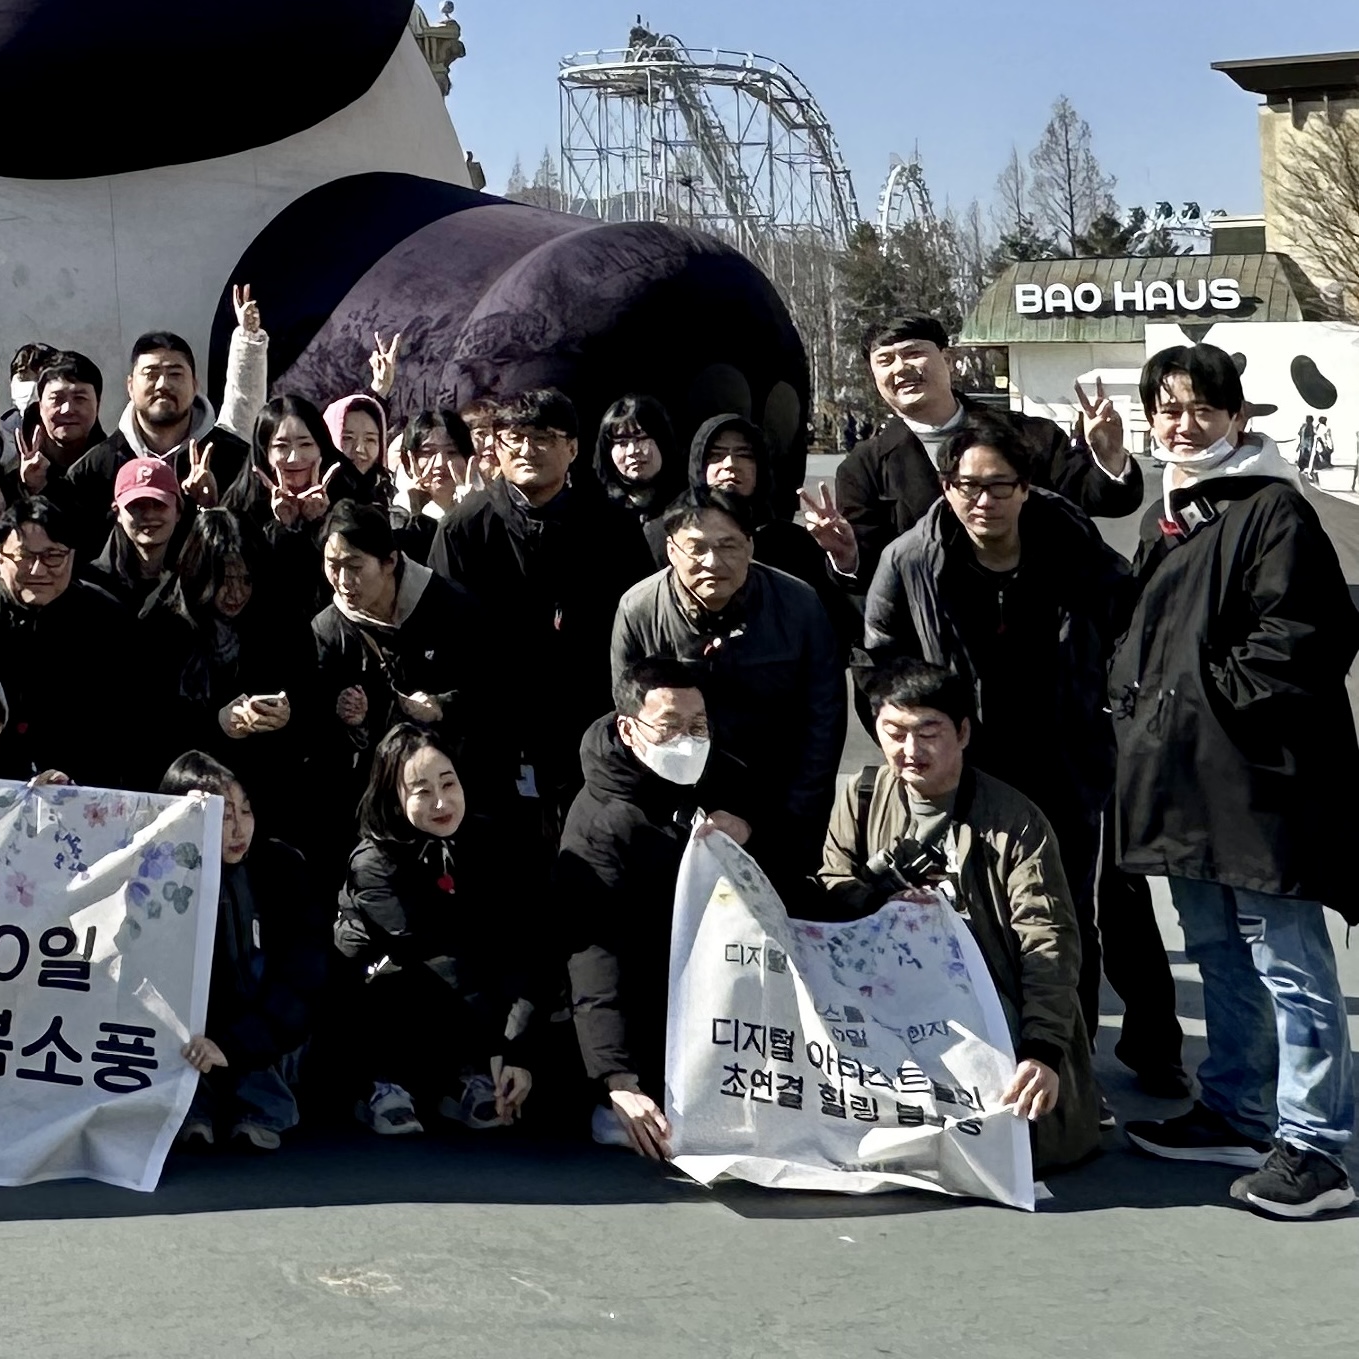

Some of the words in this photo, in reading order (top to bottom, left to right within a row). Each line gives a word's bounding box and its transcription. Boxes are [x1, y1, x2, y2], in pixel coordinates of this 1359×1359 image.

[1015, 283, 1103, 314] BAO
[1114, 278, 1241, 312] HAUS
[712, 1018, 795, 1064] 디지털
[720, 1062, 803, 1111] 초연결
